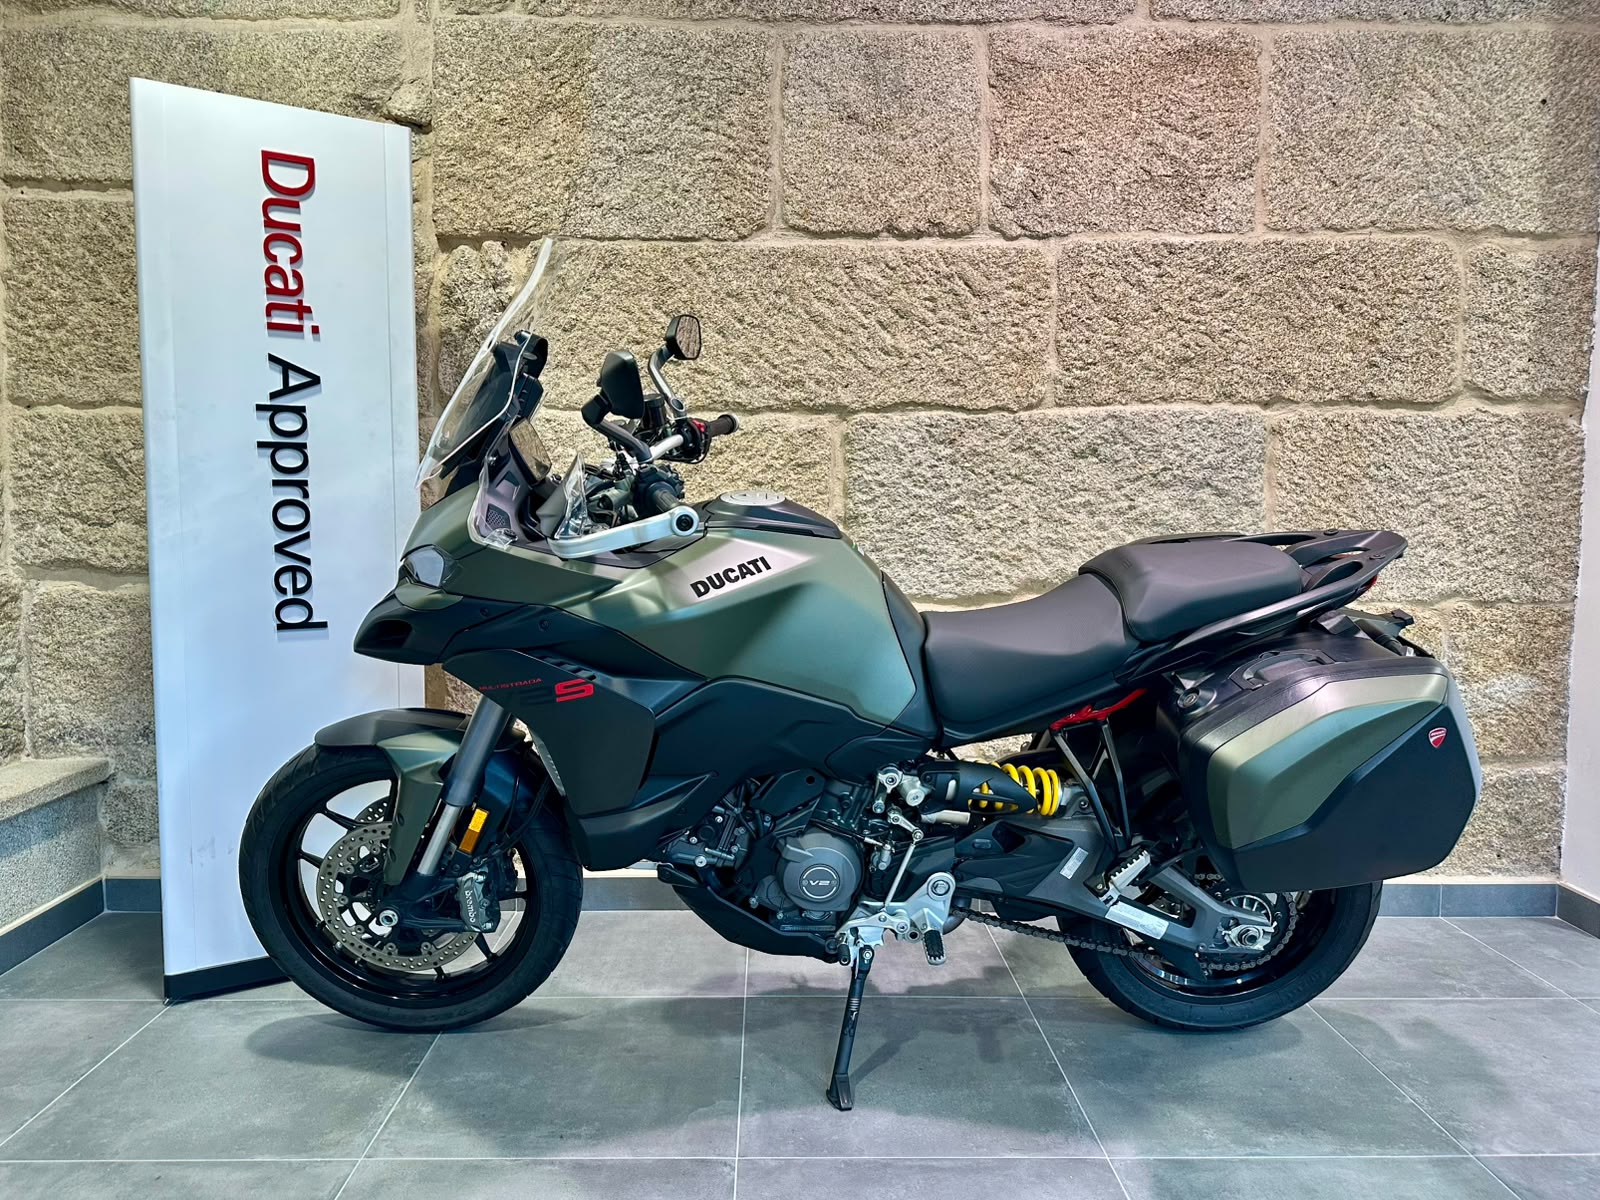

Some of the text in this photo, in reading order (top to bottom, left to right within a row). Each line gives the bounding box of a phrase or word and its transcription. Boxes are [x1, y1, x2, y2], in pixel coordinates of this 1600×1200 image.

[256, 150, 328, 631] Ducati Approved
[690, 556, 772, 598] DUCATI
[465, 890, 476, 923] brembo
